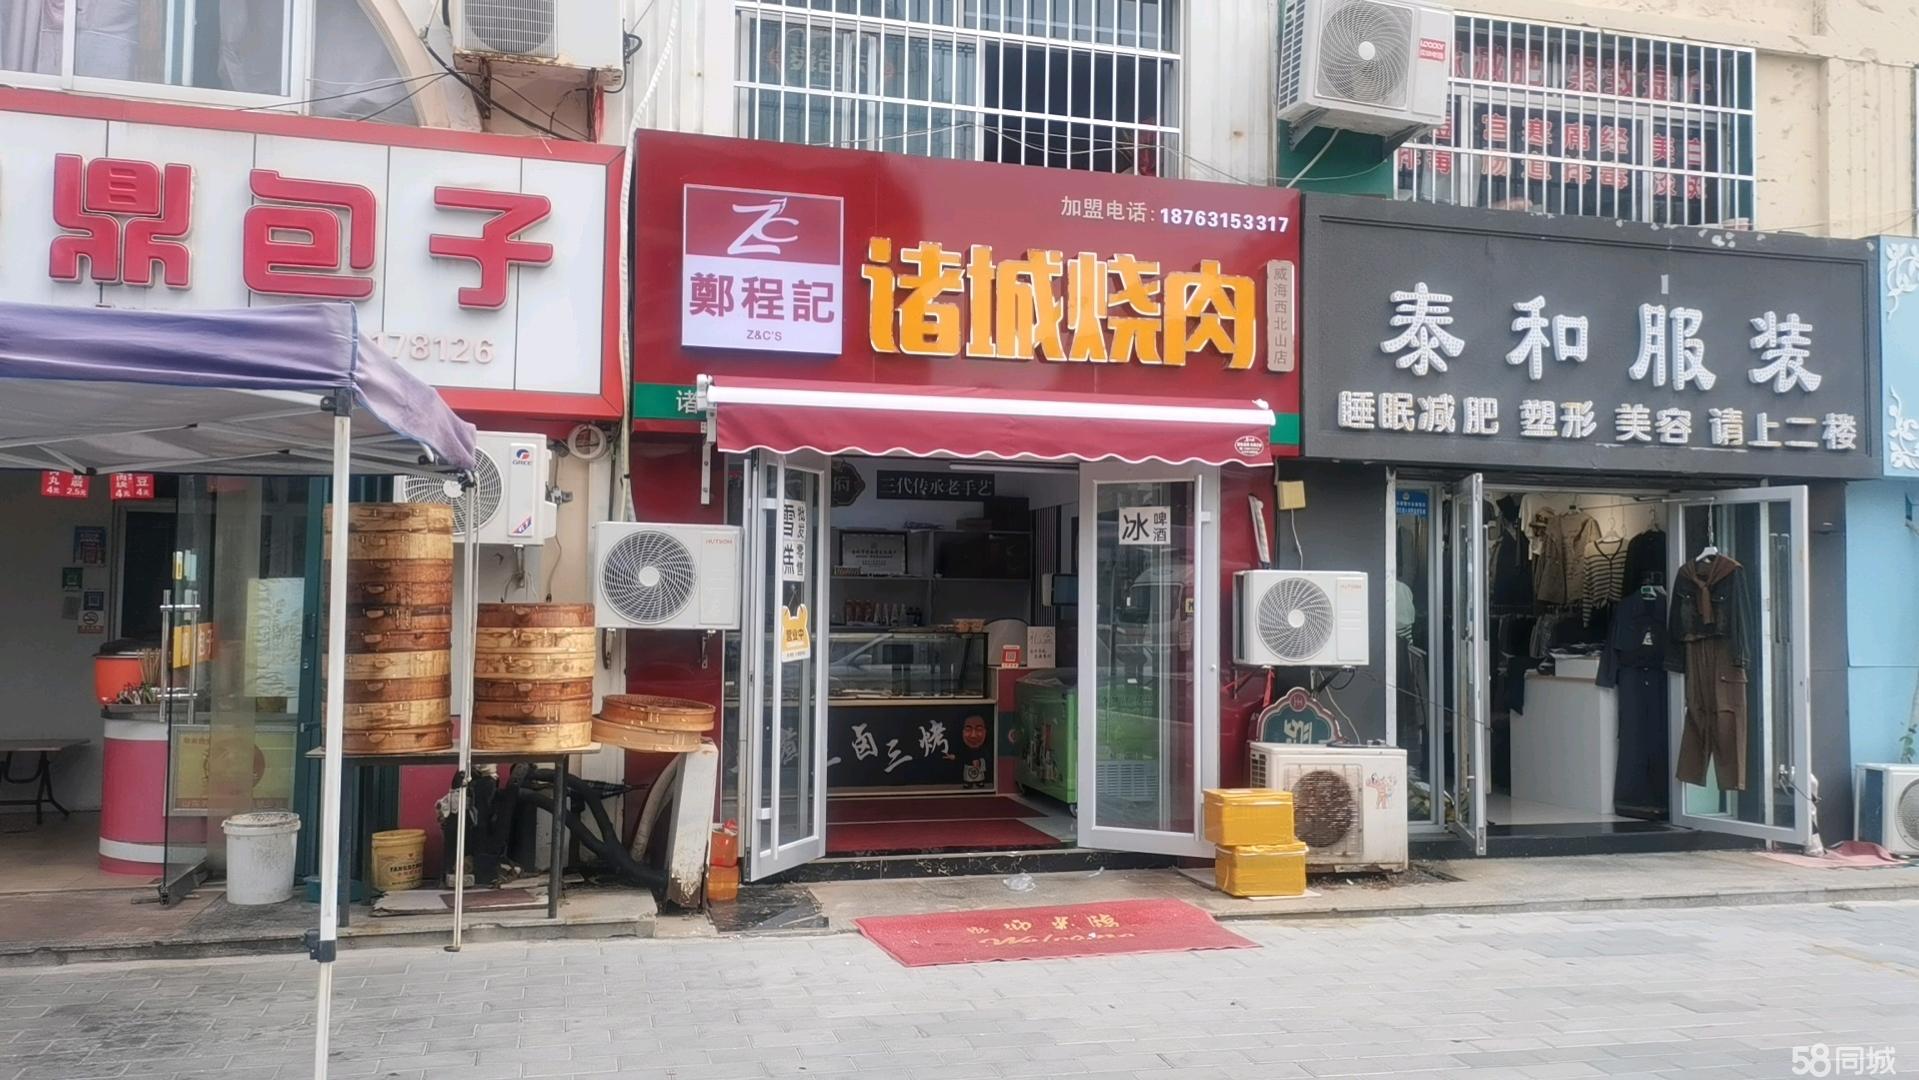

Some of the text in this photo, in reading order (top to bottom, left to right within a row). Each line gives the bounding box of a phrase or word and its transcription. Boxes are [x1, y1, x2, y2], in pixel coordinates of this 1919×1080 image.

[49, 152, 555, 311] 鼎包子
[1160, 207, 1289, 232] 18763153317
[689, 272, 835, 324] 鄭程記
[862, 237, 1257, 370] 诸城烧肉
[1272, 265, 1289, 367] 威海西北山店
[746, 329, 783, 342] Z&C'S
[1380, 281, 1822, 393] 泰和服装
[1338, 390, 1858, 451] 睡眠减肥 塑形 美容 请上二楼
[880, 477, 993, 497] 三代传承老手艺
[1122, 512, 1150, 541] 冰
[1153, 511, 1168, 542] 啤酒
